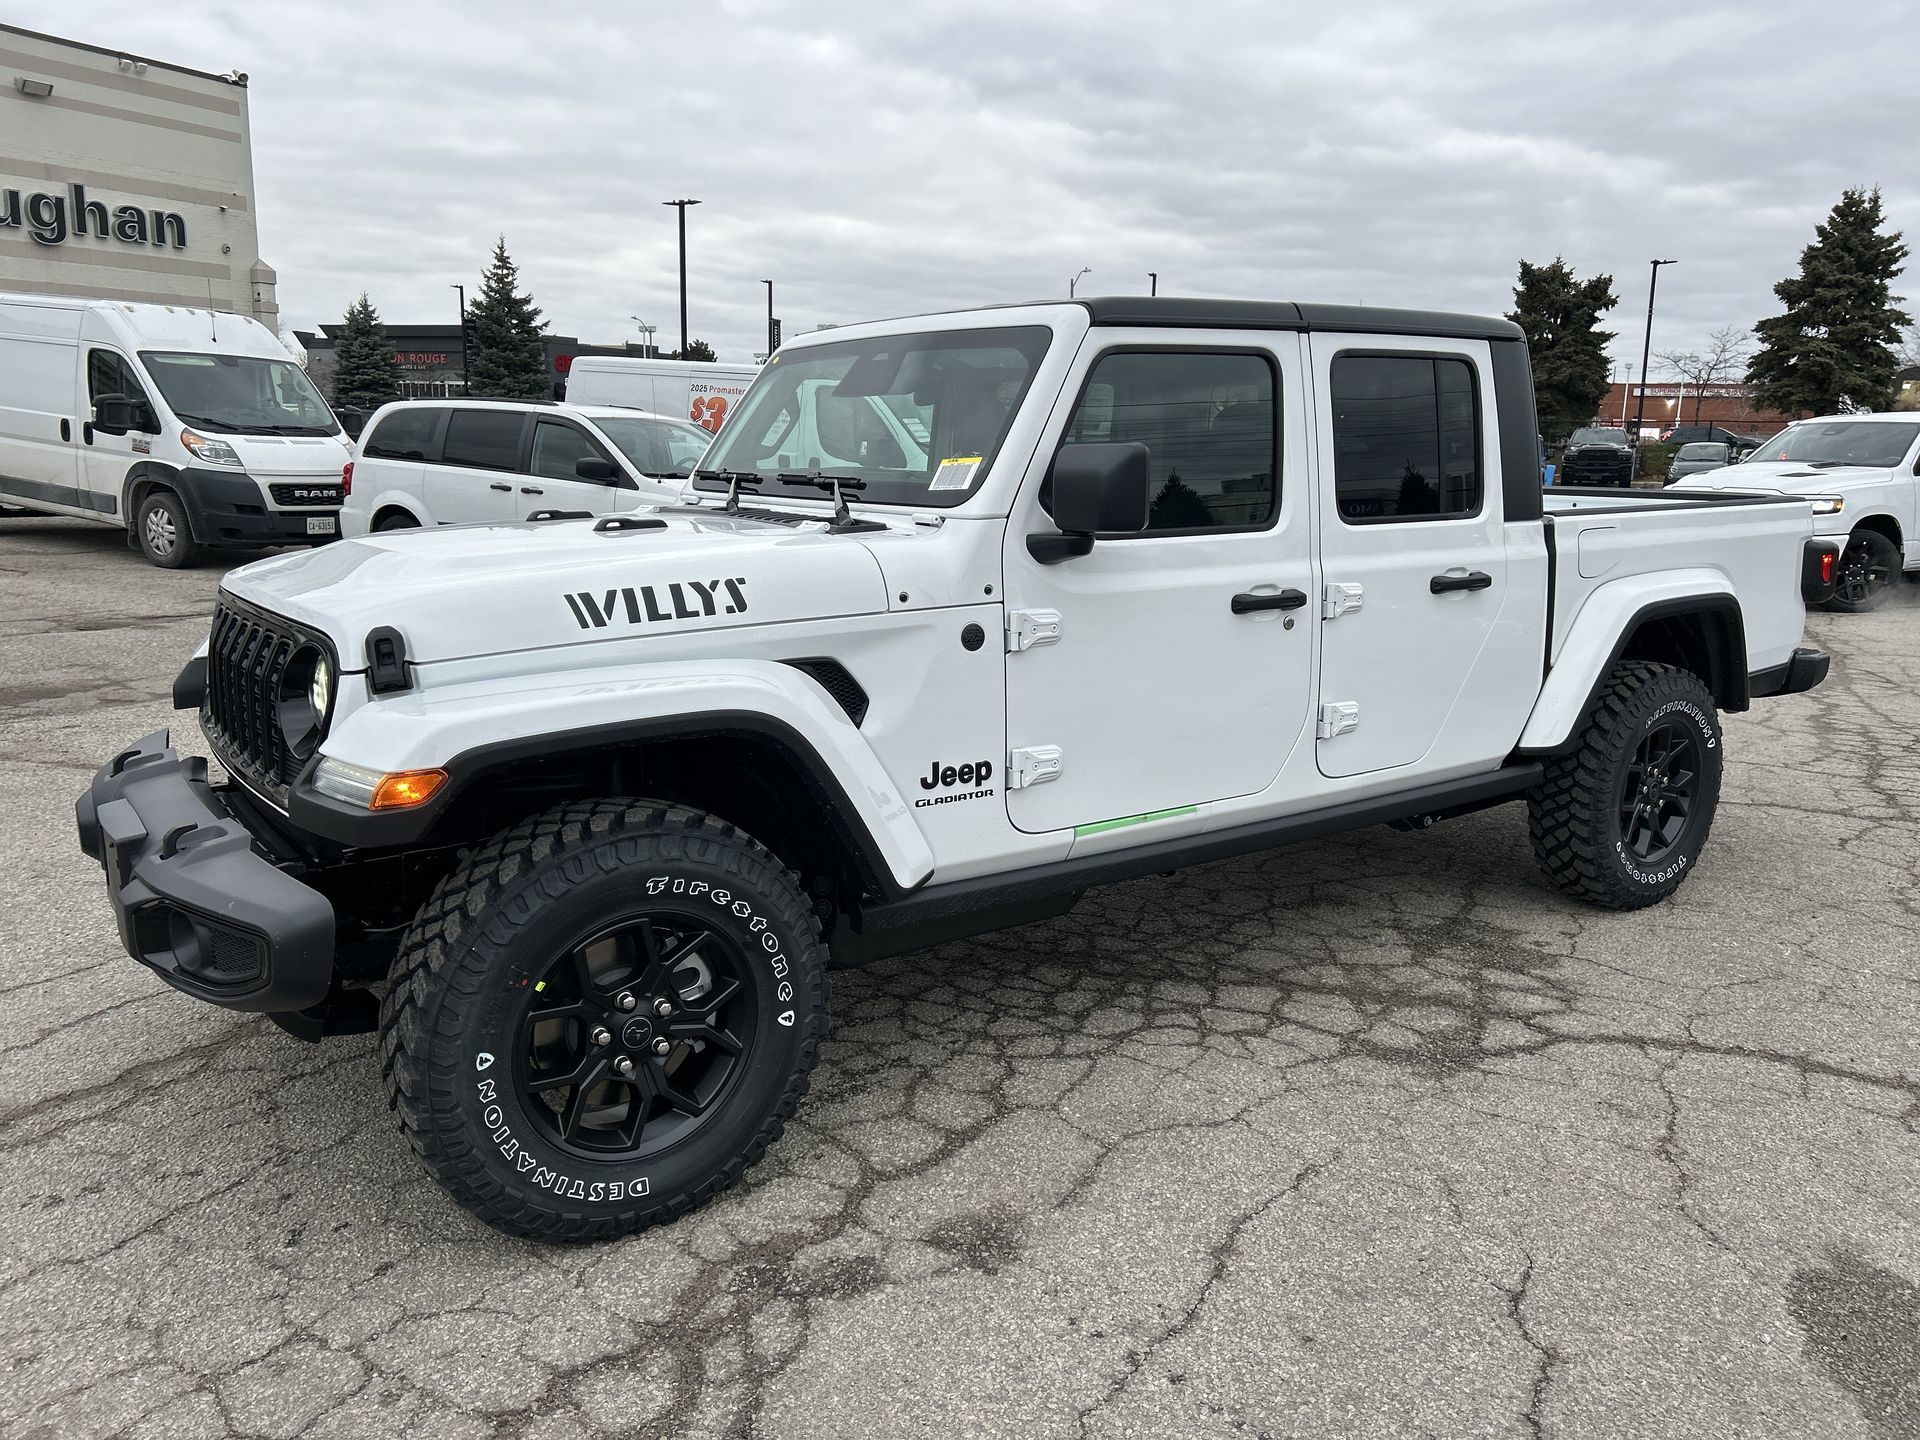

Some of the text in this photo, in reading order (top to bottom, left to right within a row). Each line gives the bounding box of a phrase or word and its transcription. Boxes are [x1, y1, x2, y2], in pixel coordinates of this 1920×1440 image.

[409, 353, 446, 363] ROUGE
[690, 384, 708, 392] 2025
[563, 577, 748, 629] WILLYS
[1645, 700, 1712, 738] DESTINATION
[920, 760, 992, 790] Jeep
[915, 789, 994, 808] GLADIATOR
[646, 876, 793, 1002] Firestone
[477, 1079, 650, 1202] DESTINATION
